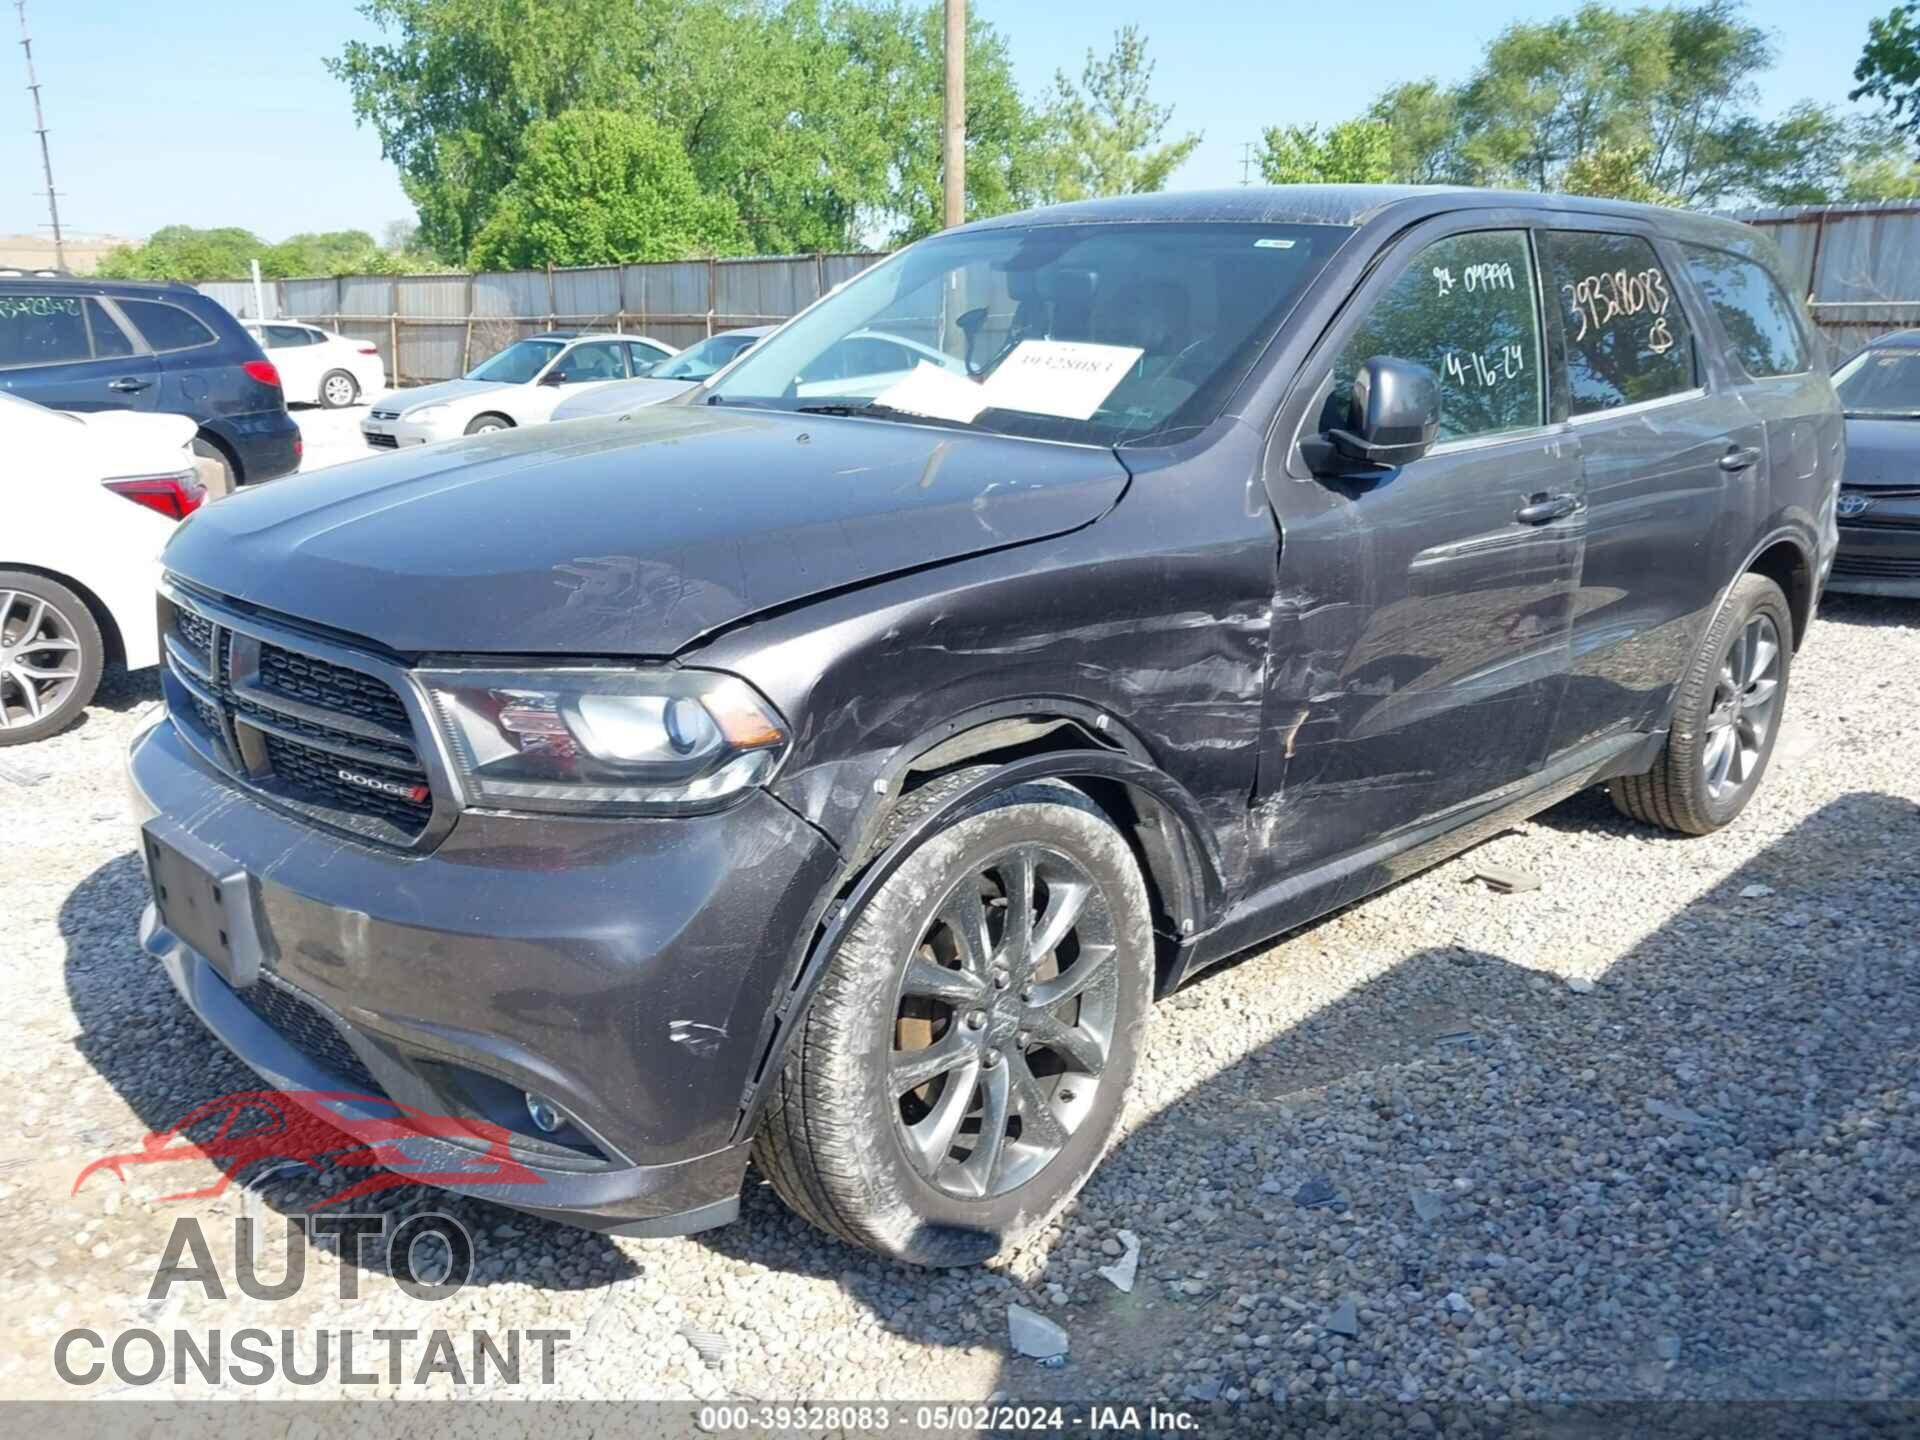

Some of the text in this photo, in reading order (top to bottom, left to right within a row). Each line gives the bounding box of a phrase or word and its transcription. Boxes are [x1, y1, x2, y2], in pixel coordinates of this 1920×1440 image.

[1562, 268, 1669, 342] 39328083
[1446, 344, 1523, 386] 4-16-24
[338, 769, 415, 799] DODGE
